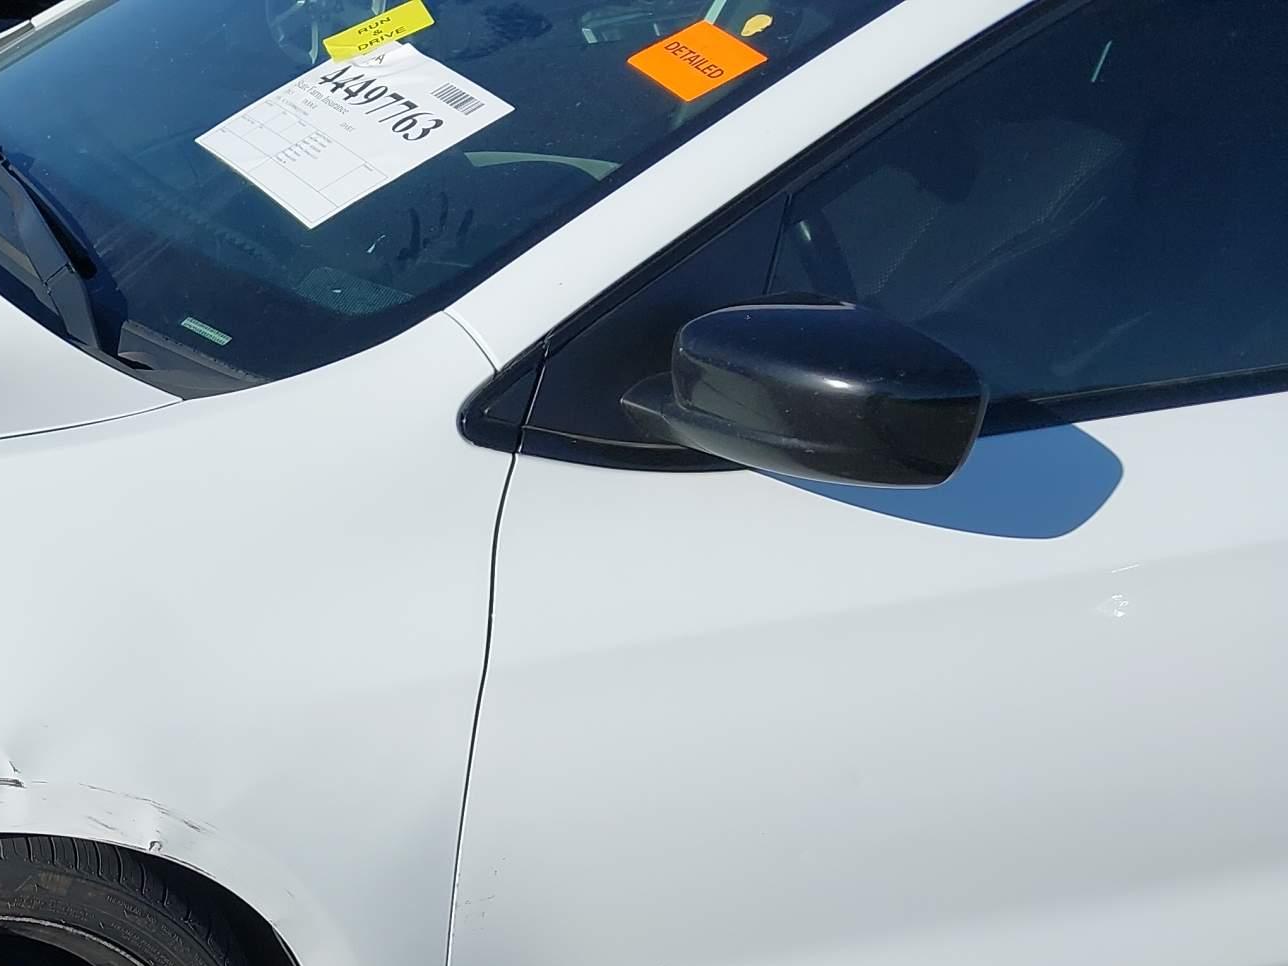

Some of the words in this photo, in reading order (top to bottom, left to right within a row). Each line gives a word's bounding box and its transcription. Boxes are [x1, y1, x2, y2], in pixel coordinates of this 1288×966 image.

[357, 16, 392, 35] RUN
[357, 26, 408, 51] DRIVE
[664, 41, 724, 79] DETAILED
[319, 65, 444, 142] 44497763
